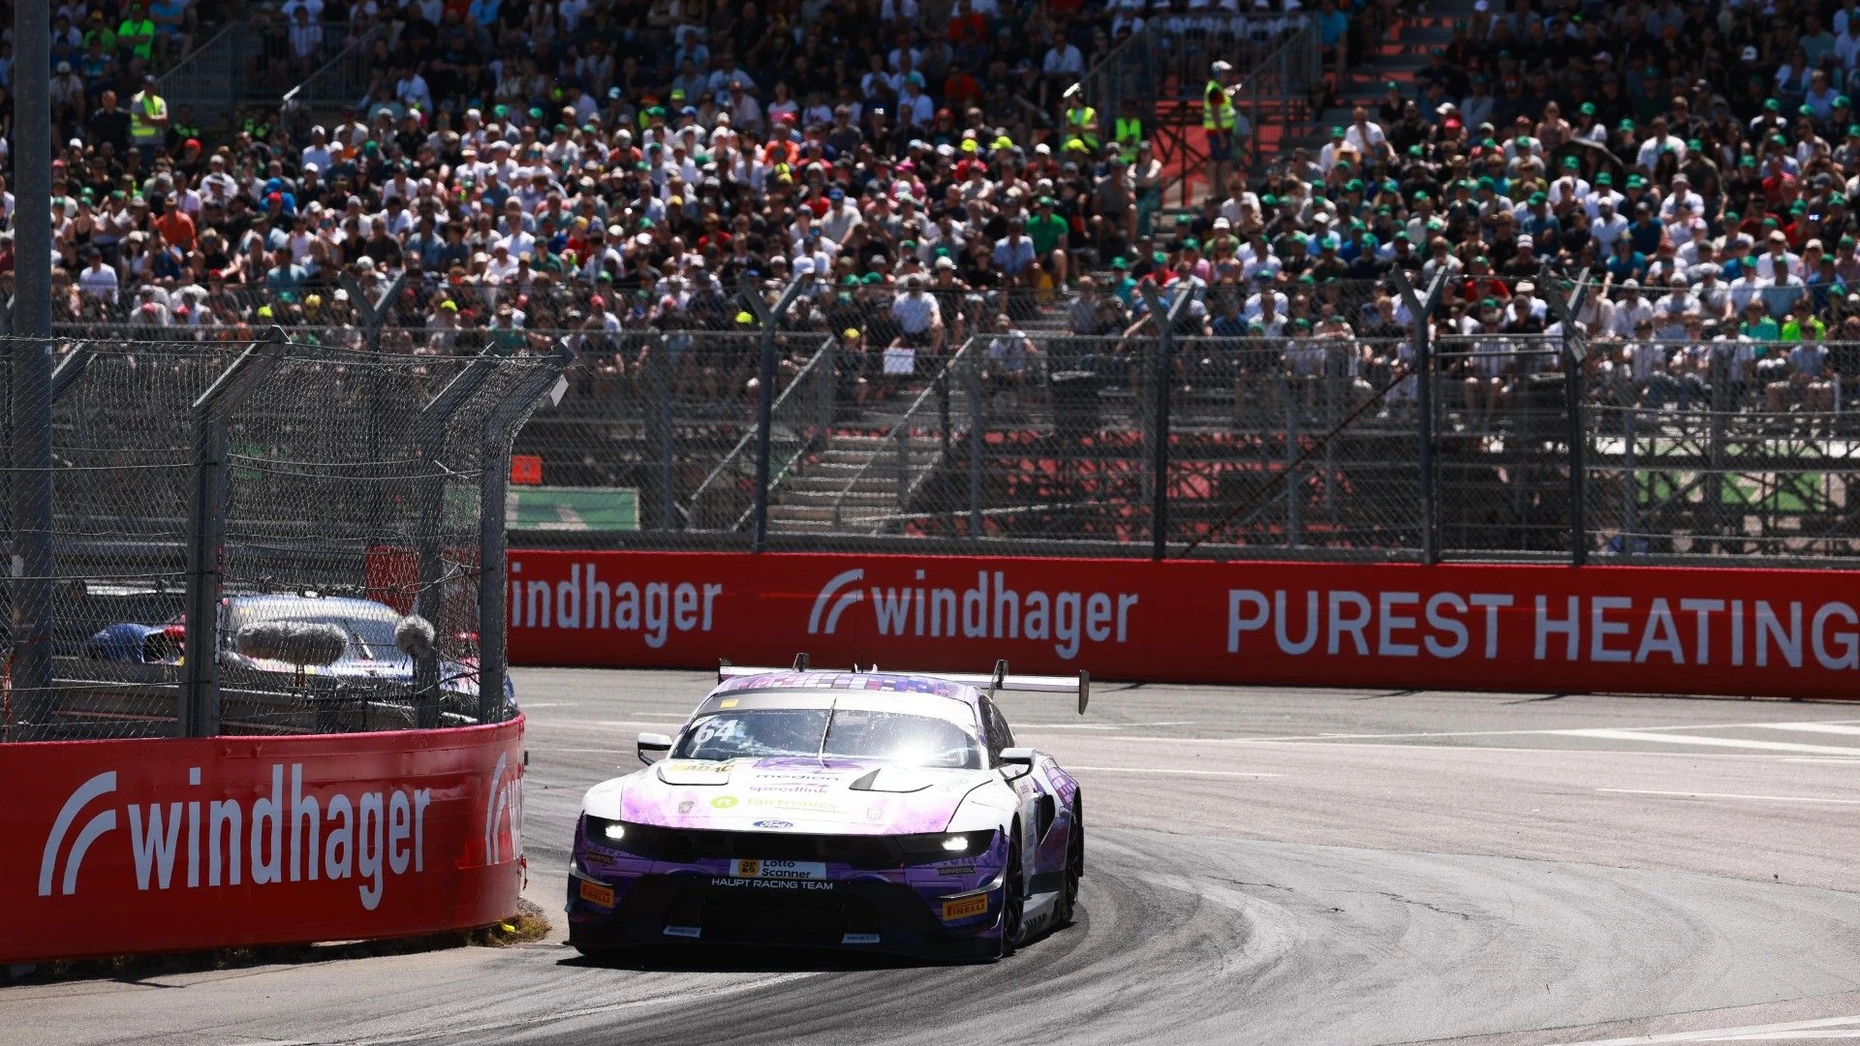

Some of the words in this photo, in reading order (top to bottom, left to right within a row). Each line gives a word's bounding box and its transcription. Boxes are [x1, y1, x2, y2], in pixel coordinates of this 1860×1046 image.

[511, 562, 722, 648] indhager
[871, 569, 1138, 660] windhager
[1228, 589, 1514, 659] PUREST
[1534, 595, 1860, 670] HEATING
[693, 719, 738, 744] 64
[127, 763, 430, 911] windhager
[762, 868, 811, 879] Scanner
[763, 859, 796, 868] Lotto
[711, 878, 750, 887] HAUPT
[753, 879, 798, 889] RACING
[801, 881, 833, 890] TEAM
[946, 898, 986, 917] PIRELLI
